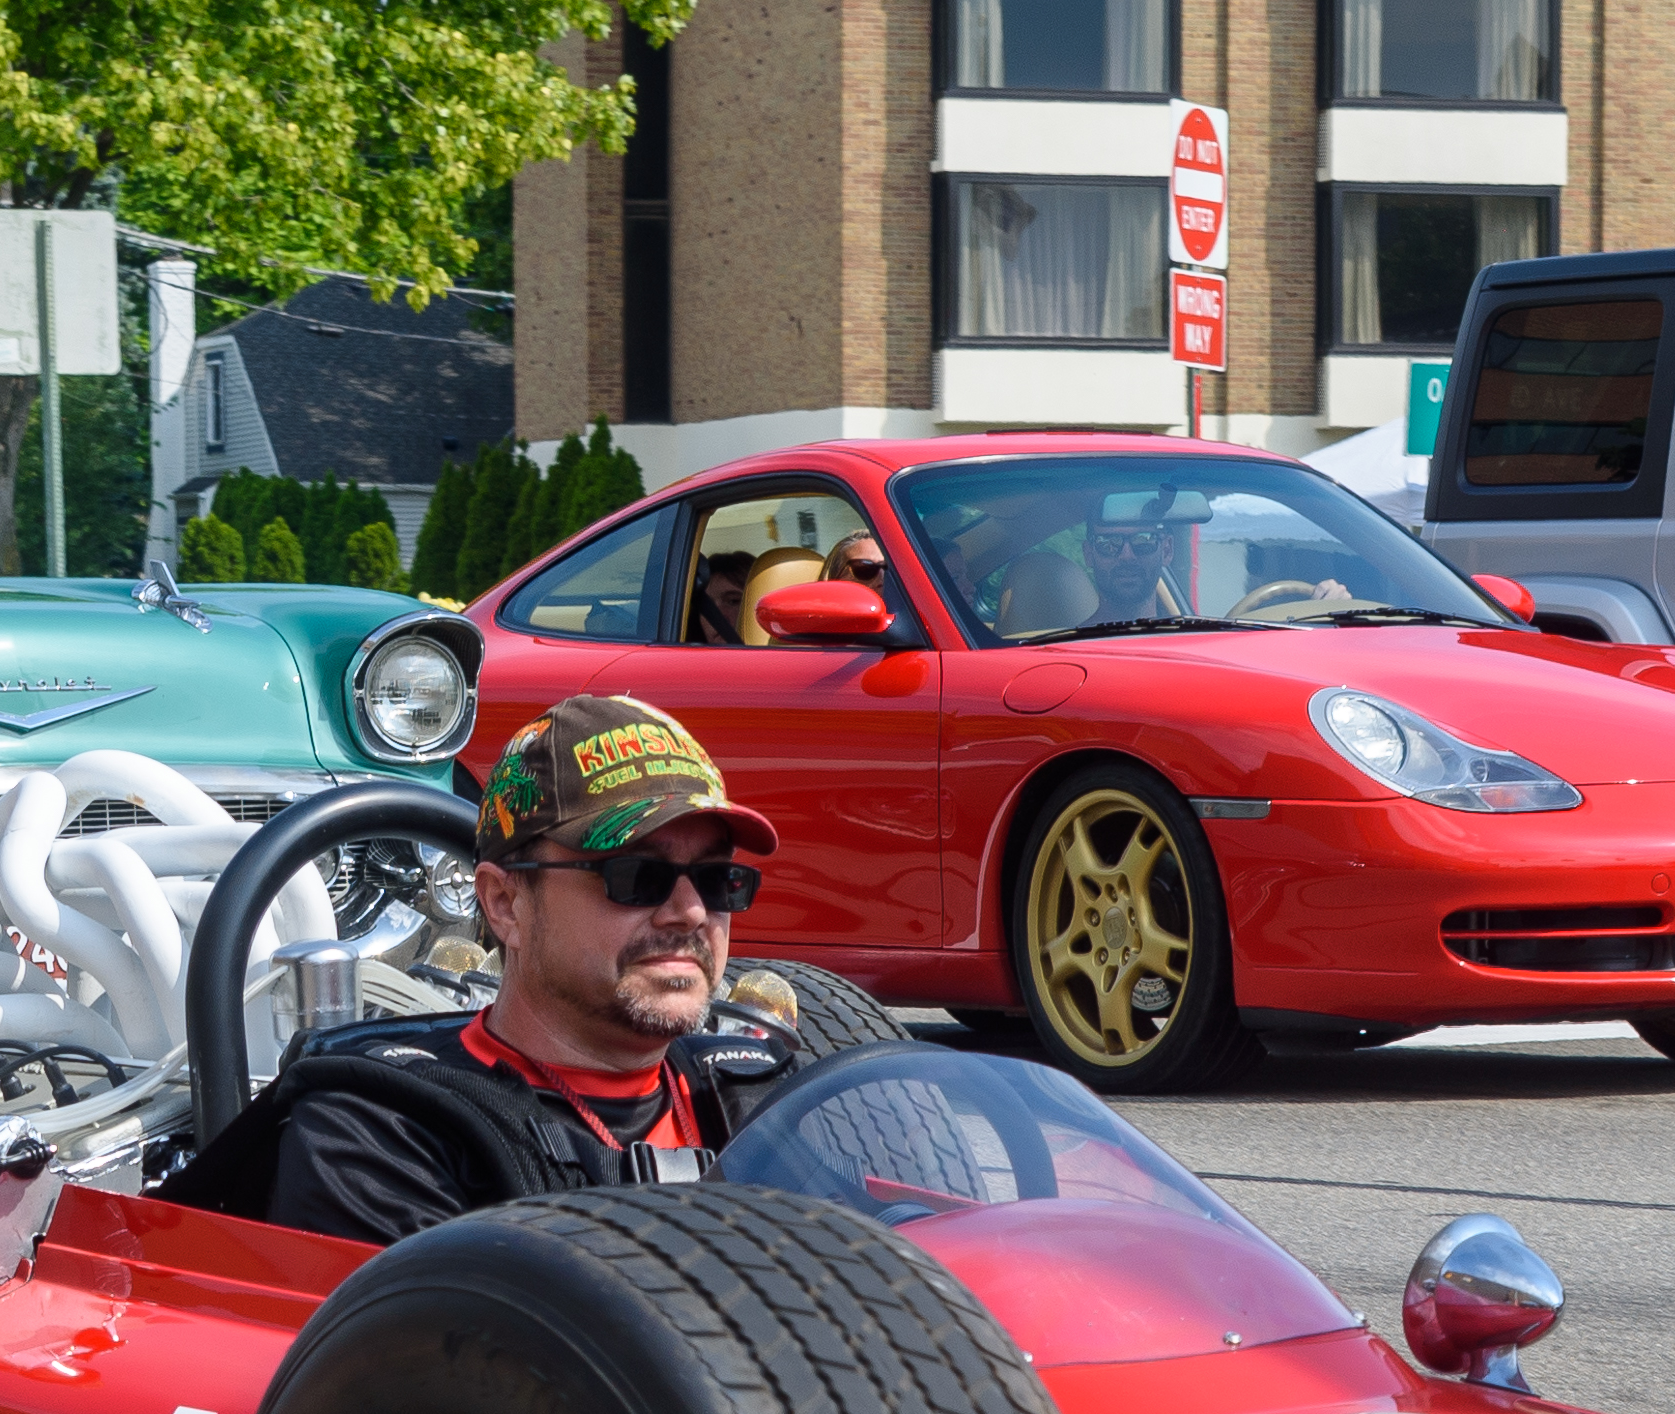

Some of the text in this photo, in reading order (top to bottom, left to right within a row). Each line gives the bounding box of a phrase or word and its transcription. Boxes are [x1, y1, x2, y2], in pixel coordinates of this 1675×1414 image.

[1178, 134, 1219, 164] DO NOT
[1181, 205, 1215, 232] ENTER
[1177, 285, 1221, 319] WRONG
[1184, 322, 1212, 354] WAY
[587, 764, 643, 795] FUEL
[702, 1050, 778, 1065] TANAKA
